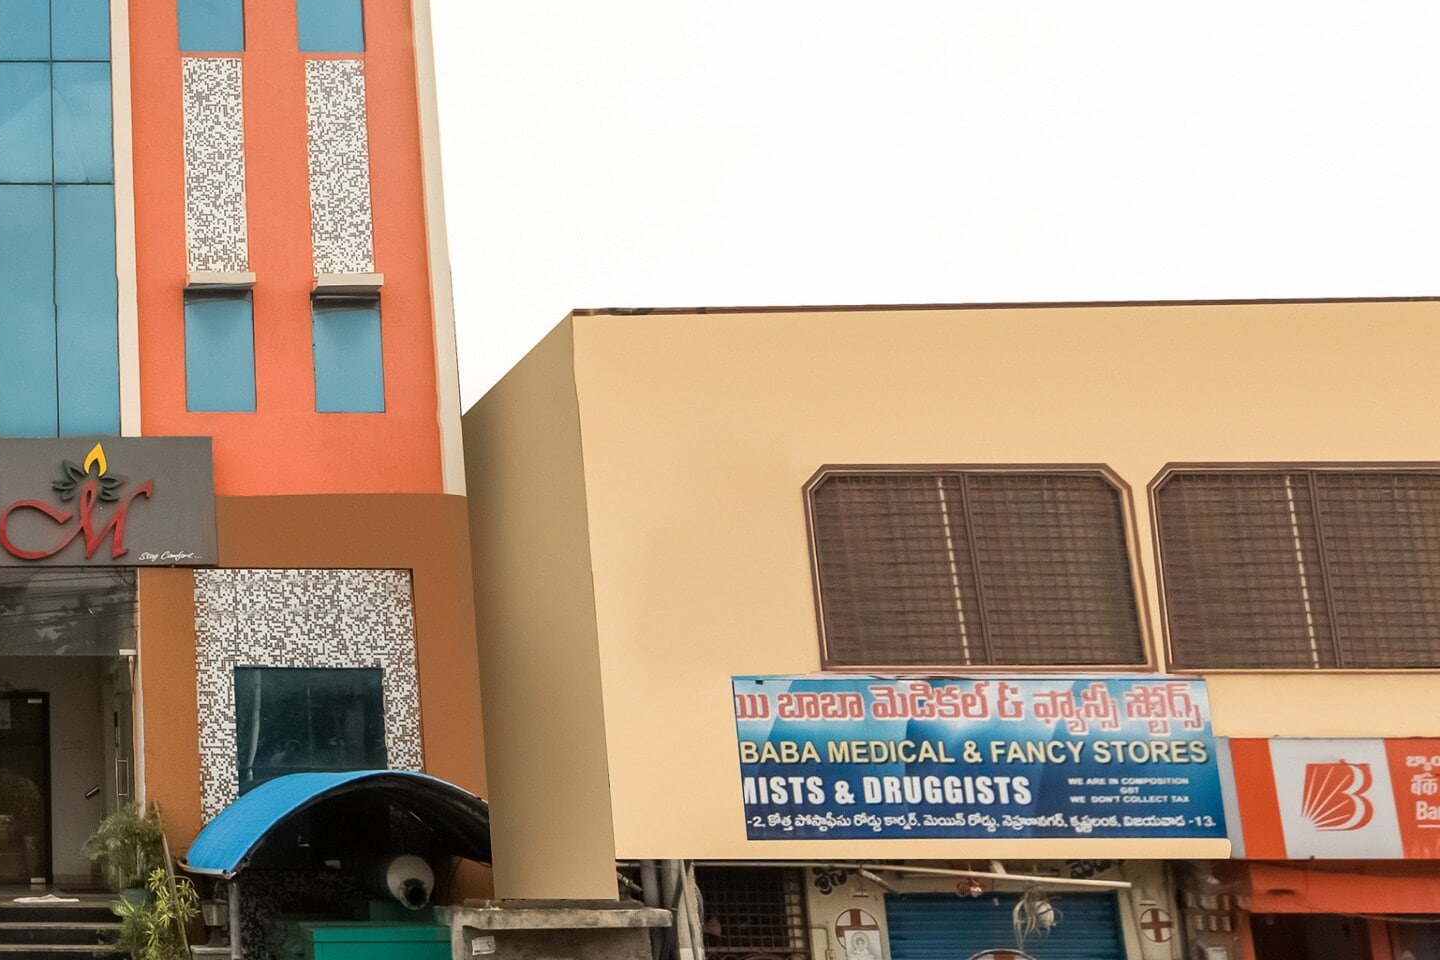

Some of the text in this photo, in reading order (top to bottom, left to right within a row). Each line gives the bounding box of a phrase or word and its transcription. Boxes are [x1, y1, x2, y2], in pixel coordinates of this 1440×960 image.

[138, 551, 159, 562] Stay
[777, 692, 864, 720] బాబా
[870, 681, 990, 720] మెడికల్
[739, 739, 1208, 764] BABA MEDICAL & FANCY STORES
[1068, 777, 1190, 785] WE ARE IN COMPOSITION
[743, 774, 1033, 805] MISTS & DRUGGISTS
[1119, 786, 1140, 794] GST
[1069, 795, 1190, 803] WE DON'T COLLECT TAX
